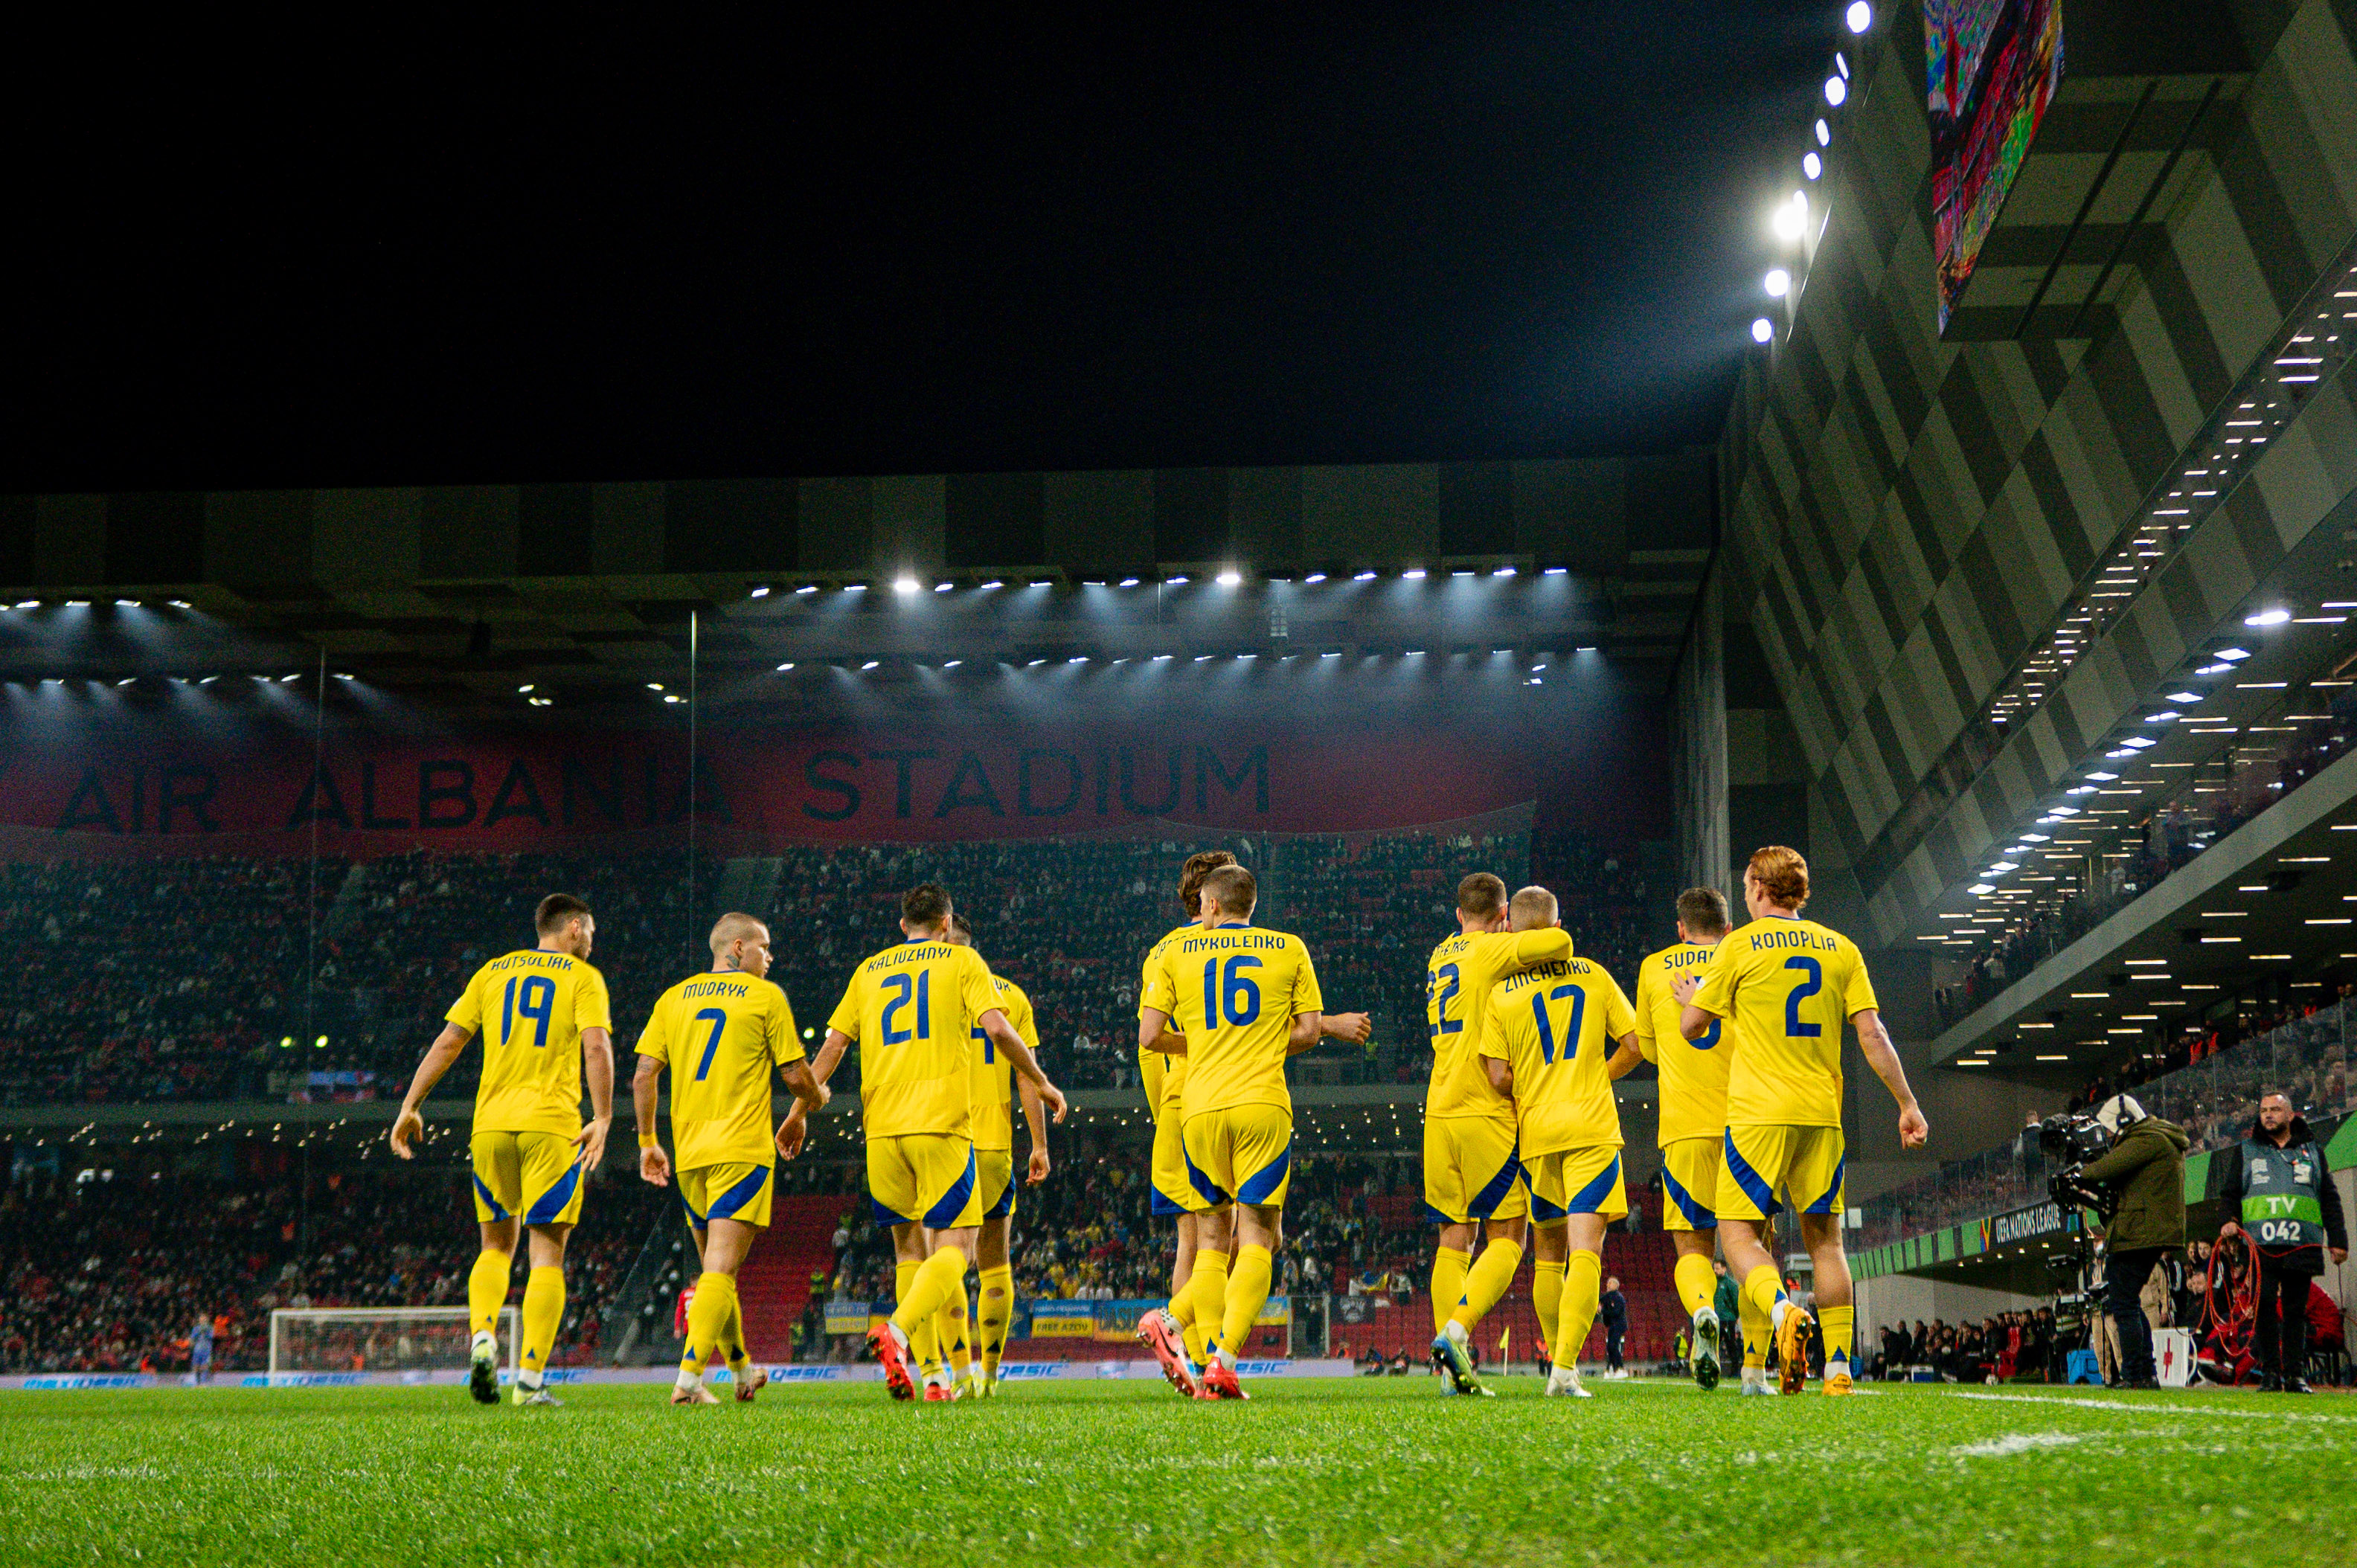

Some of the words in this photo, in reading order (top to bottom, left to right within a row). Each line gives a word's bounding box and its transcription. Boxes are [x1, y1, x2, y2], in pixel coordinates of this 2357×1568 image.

[54, 763, 220, 835] AIR
[285, 754, 732, 831] ALBANIA
[801, 745, 1268, 823] STADIUM
[868, 947, 952, 973] KALIUZHNYI
[1183, 936, 1285, 954] MYKOLENKO
[1751, 931, 1838, 951] KONOPLIA
[683, 982, 748, 999] MUDRYK
[1204, 955, 1263, 1030] 16
[1505, 960, 1591, 993] ZINCHENKO
[1784, 956, 1822, 1037] 2
[501, 975, 556, 1047] 19
[880, 968, 929, 1047] 21
[1532, 983, 1585, 1065] 17
[696, 1008, 727, 1081] 7
[1995, 1217, 2010, 1244] UEFA
[2010, 1208, 2036, 1240] NATIONS
[2035, 1201, 2061, 1233] LEAGUE
[2265, 1196, 2297, 1214] TV
[2262, 1221, 2300, 1241] 042
